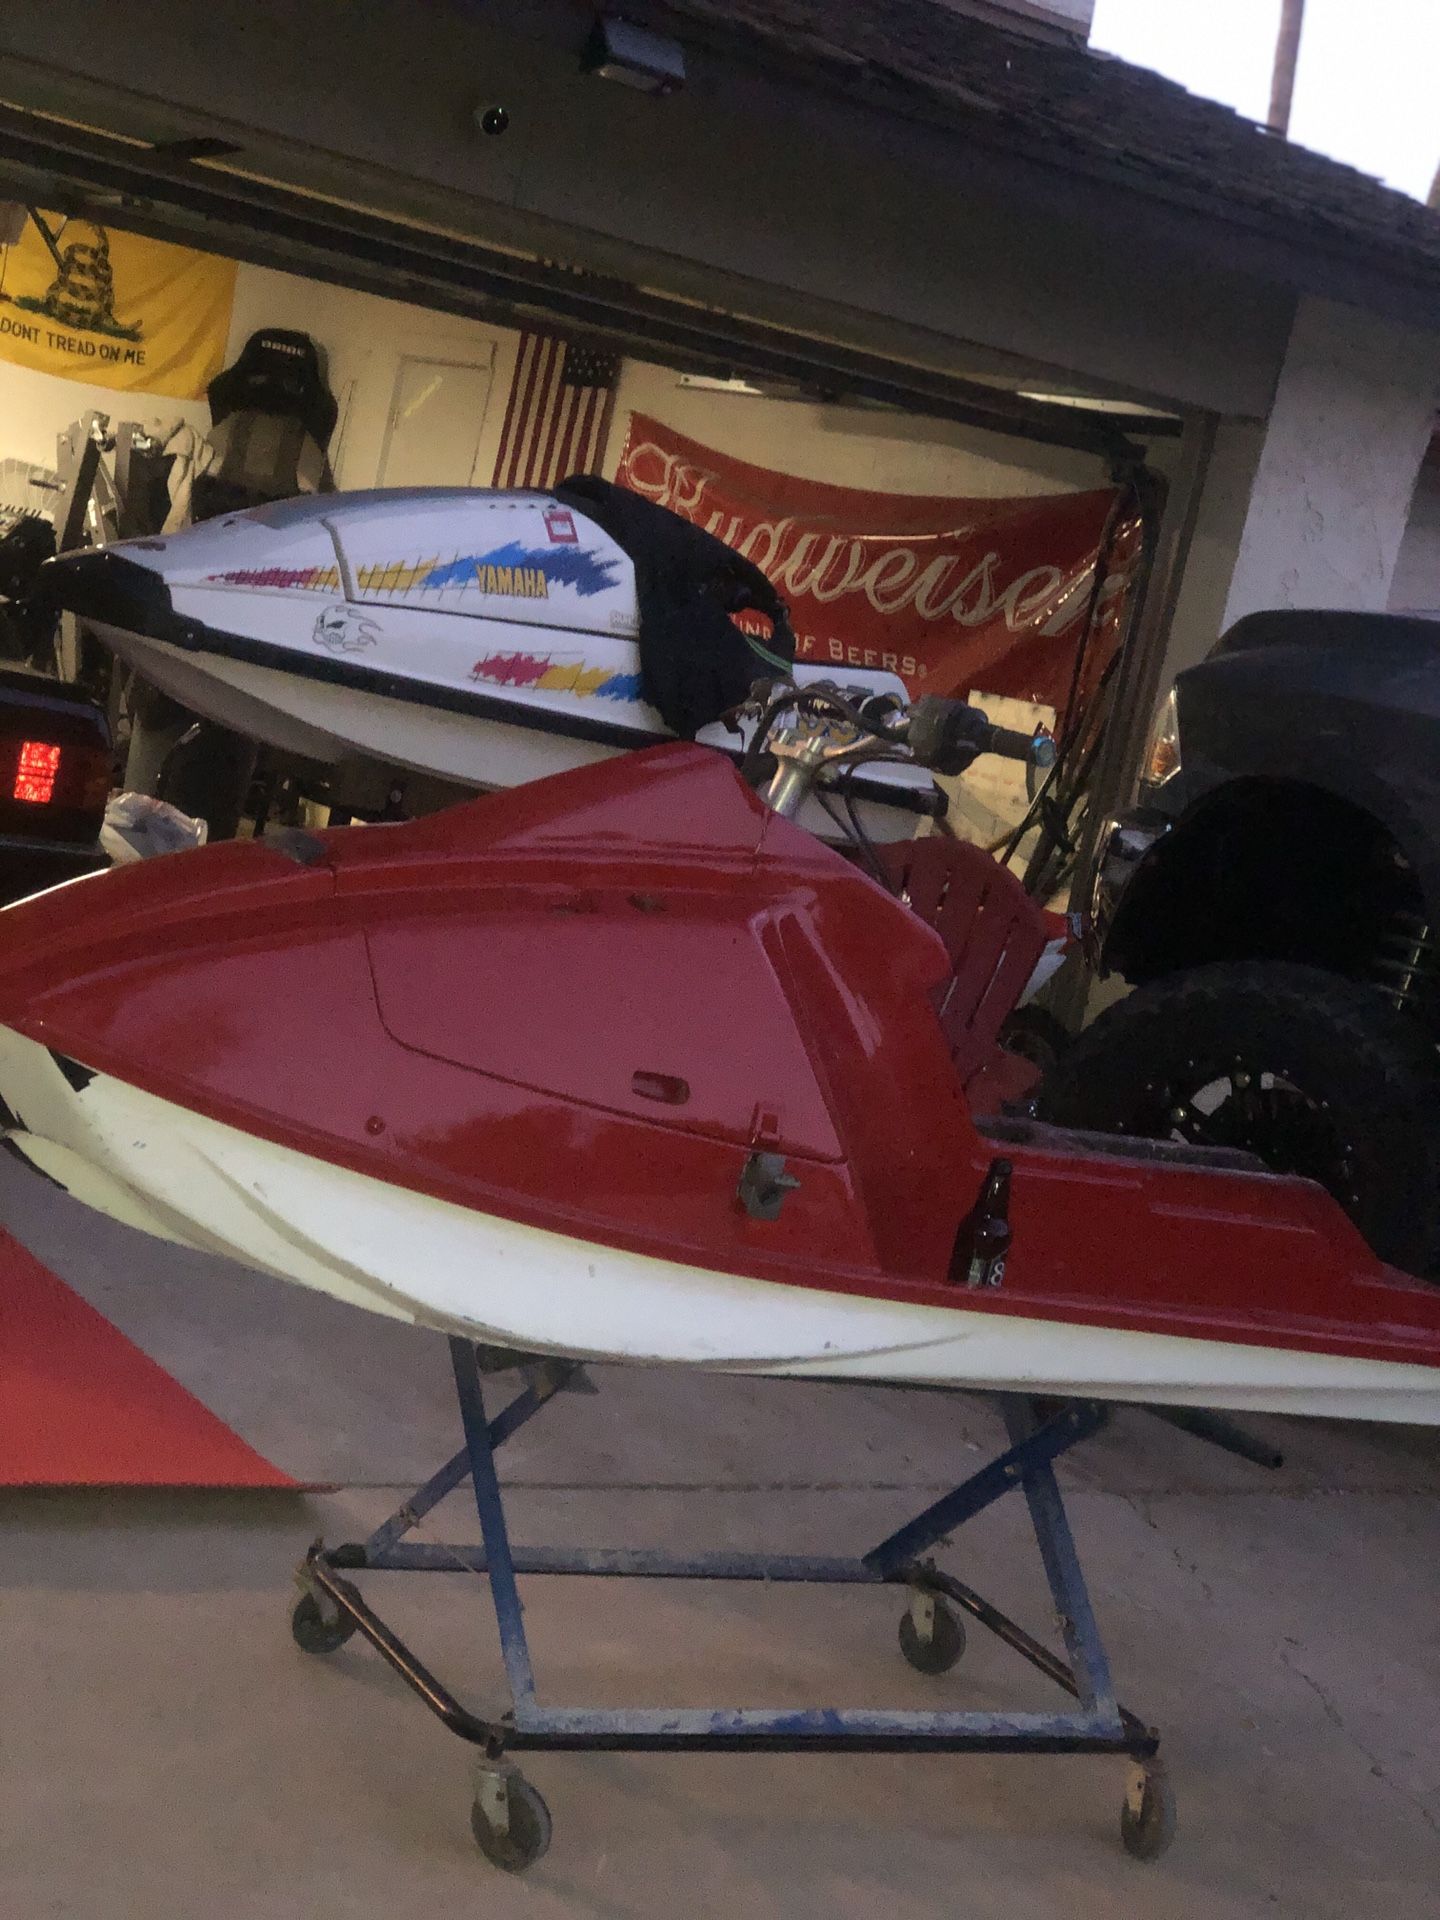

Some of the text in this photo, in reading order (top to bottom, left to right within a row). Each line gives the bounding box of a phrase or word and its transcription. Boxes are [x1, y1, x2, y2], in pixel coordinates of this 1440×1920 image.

[0, 316, 146, 366] DONT TREAD ON ME
[476, 564, 548, 599] YAMAHA
